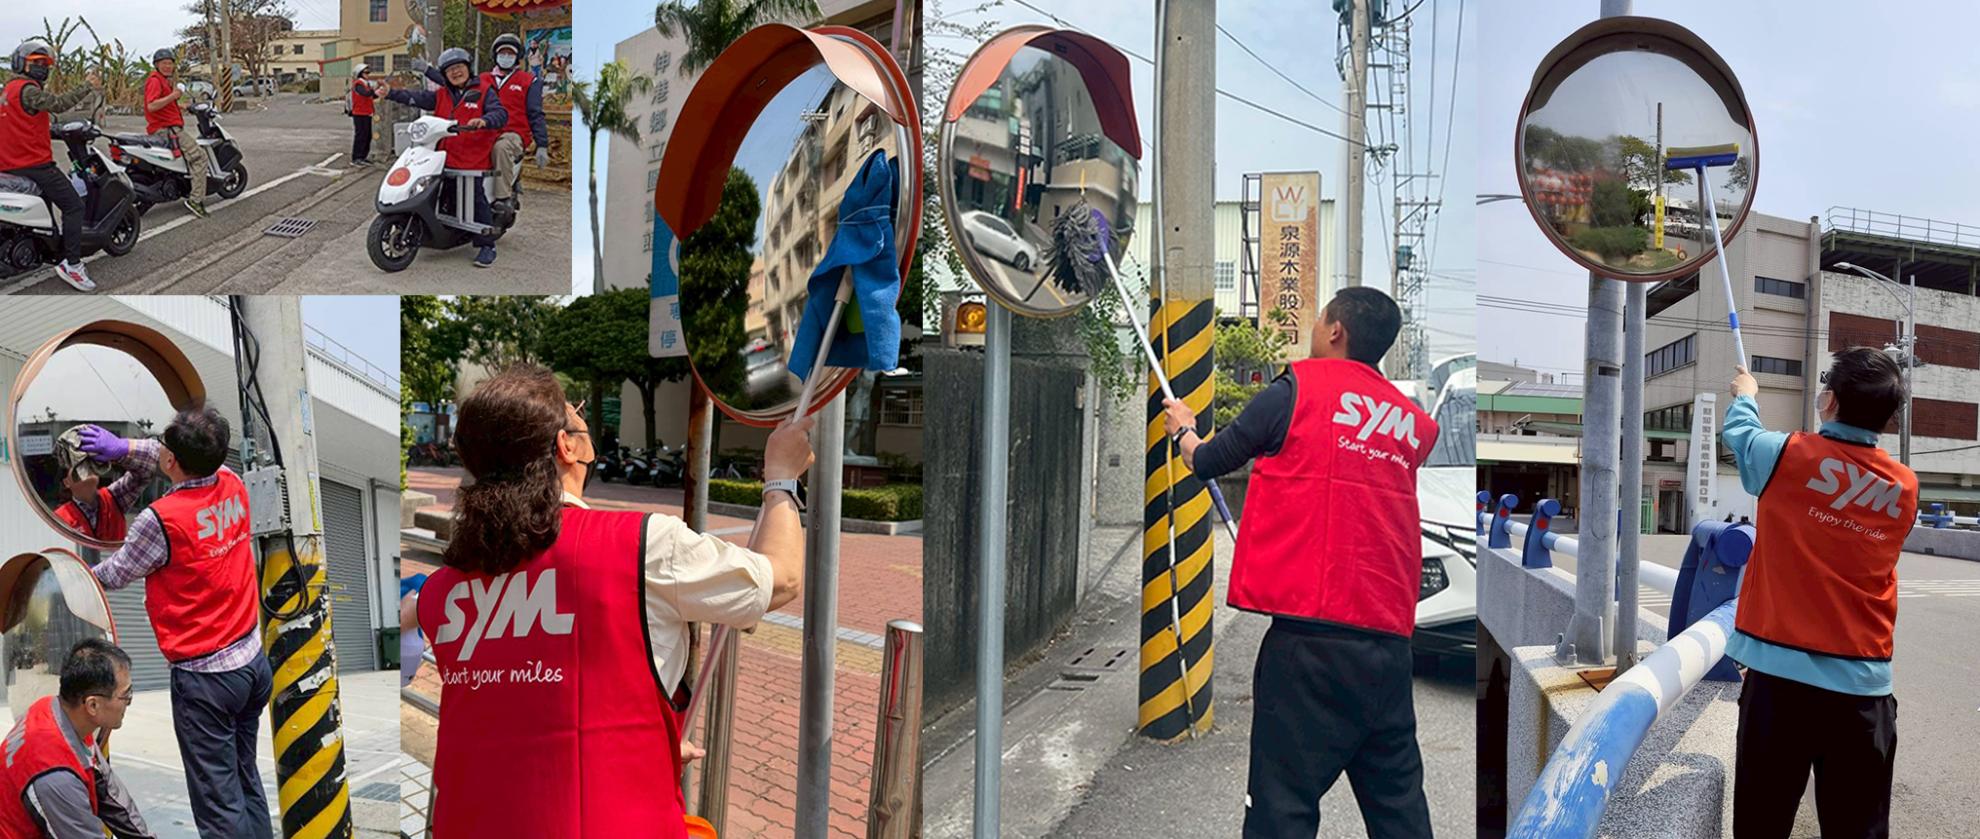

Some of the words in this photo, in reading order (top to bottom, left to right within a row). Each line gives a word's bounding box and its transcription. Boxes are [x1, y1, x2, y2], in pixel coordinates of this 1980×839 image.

[1332, 391, 1420, 449] SYM
[1806, 457, 1904, 519] SYM
[196, 494, 247, 542] SYM
[1808, 506, 1842, 527] Enjoy
[1843, 519, 1865, 533] the
[434, 568, 576, 662] SYM
[471, 668, 505, 690] your
[510, 660, 564, 683] miles
